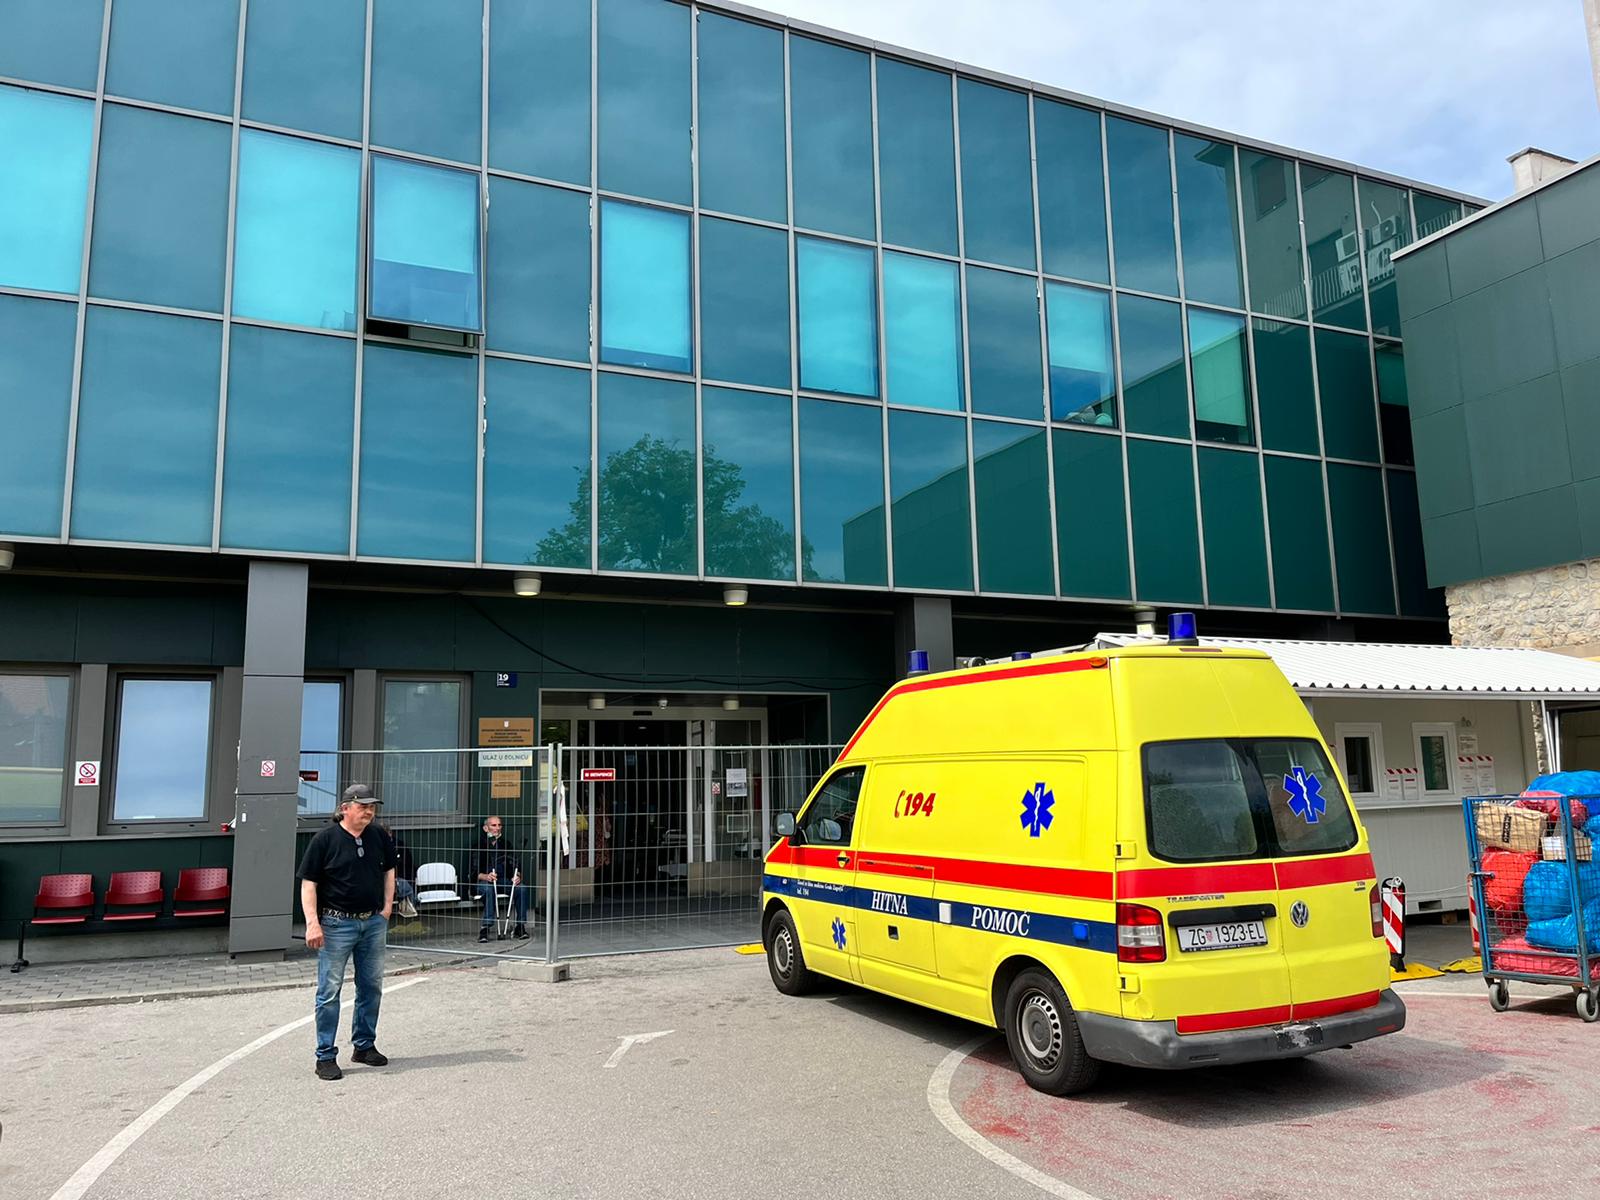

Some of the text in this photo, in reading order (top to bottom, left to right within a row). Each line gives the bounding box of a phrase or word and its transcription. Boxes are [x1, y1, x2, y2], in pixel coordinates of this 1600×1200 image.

[498, 673, 509, 682] 19
[904, 791, 936, 817] 194
[871, 891, 1031, 937] HITNA POMOĆ
[1188, 928, 1207, 946] ZG
